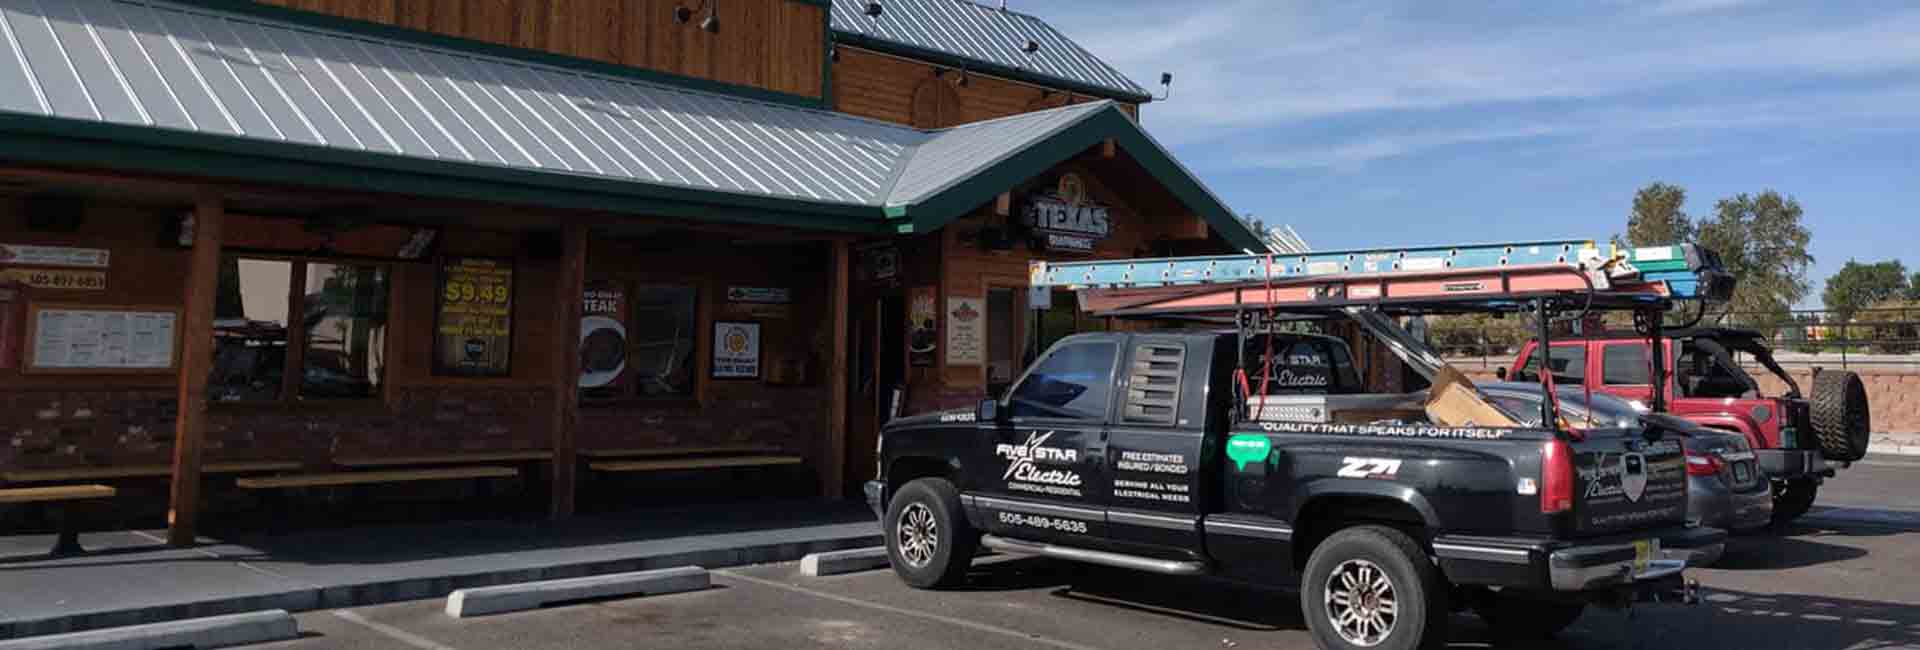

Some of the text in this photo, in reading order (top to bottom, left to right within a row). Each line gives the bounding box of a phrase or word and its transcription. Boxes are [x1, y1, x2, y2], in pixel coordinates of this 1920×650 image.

[1038, 202, 1107, 236] TEXAS
[583, 299, 617, 313] TEAK
[1278, 368, 1328, 387] Electric
[1320, 423, 1356, 434] THAT
[1360, 424, 1416, 437] SPEAKS
[1418, 427, 1450, 438] FOR
[996, 443, 1077, 462] FIVE STAR
[1014, 462, 1083, 487] Electric
[1149, 482, 1165, 491] ALL
[1166, 483, 1189, 493] YOUR
